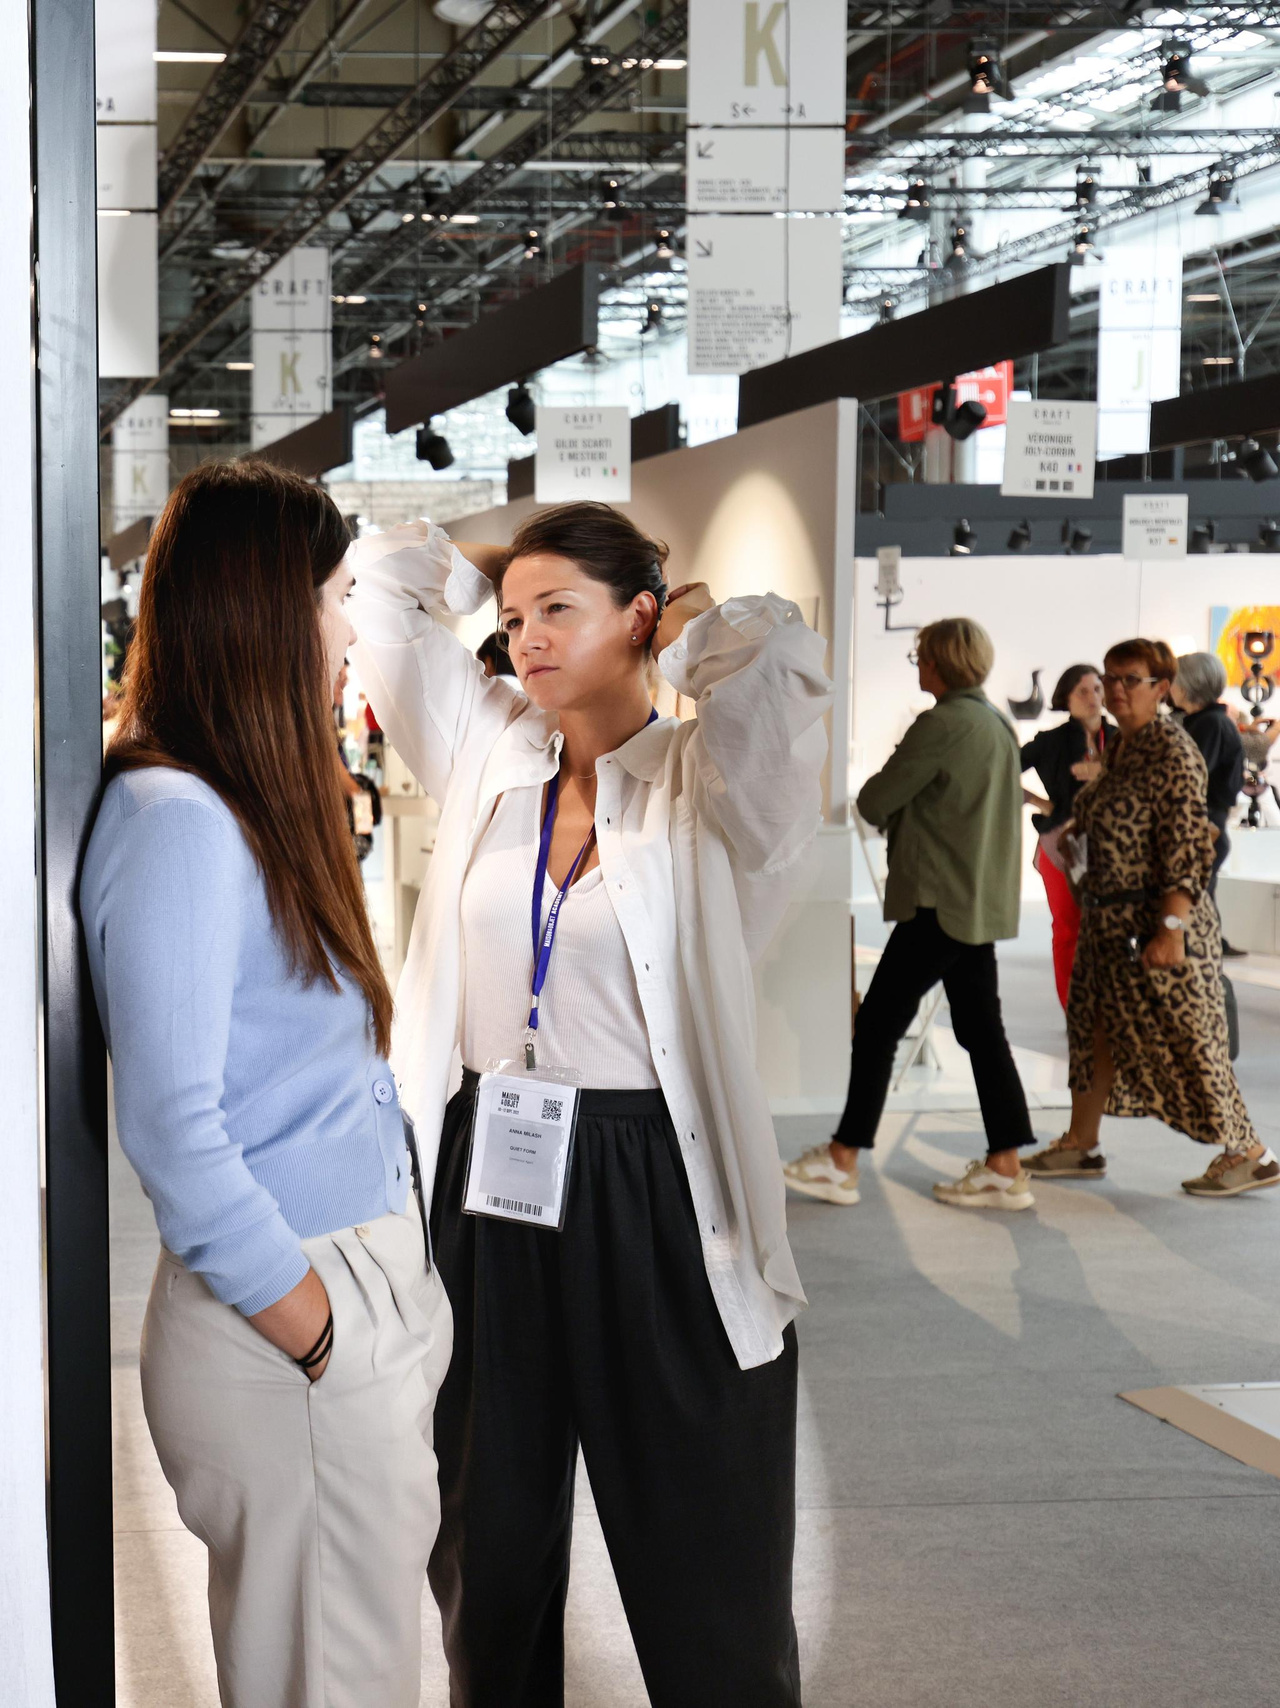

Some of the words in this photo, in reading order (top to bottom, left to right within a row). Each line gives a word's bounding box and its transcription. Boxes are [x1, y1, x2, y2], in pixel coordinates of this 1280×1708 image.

[745, 2, 788, 86] K
[798, 103, 807, 118] A
[256, 279, 326, 297] CRAFT
[1109, 278, 1176, 295] CRAFT
[279, 351, 303, 396] K
[563, 414, 603, 424] CRAFT
[1034, 408, 1071, 419] CRAFT
[131, 465, 149, 494] K
